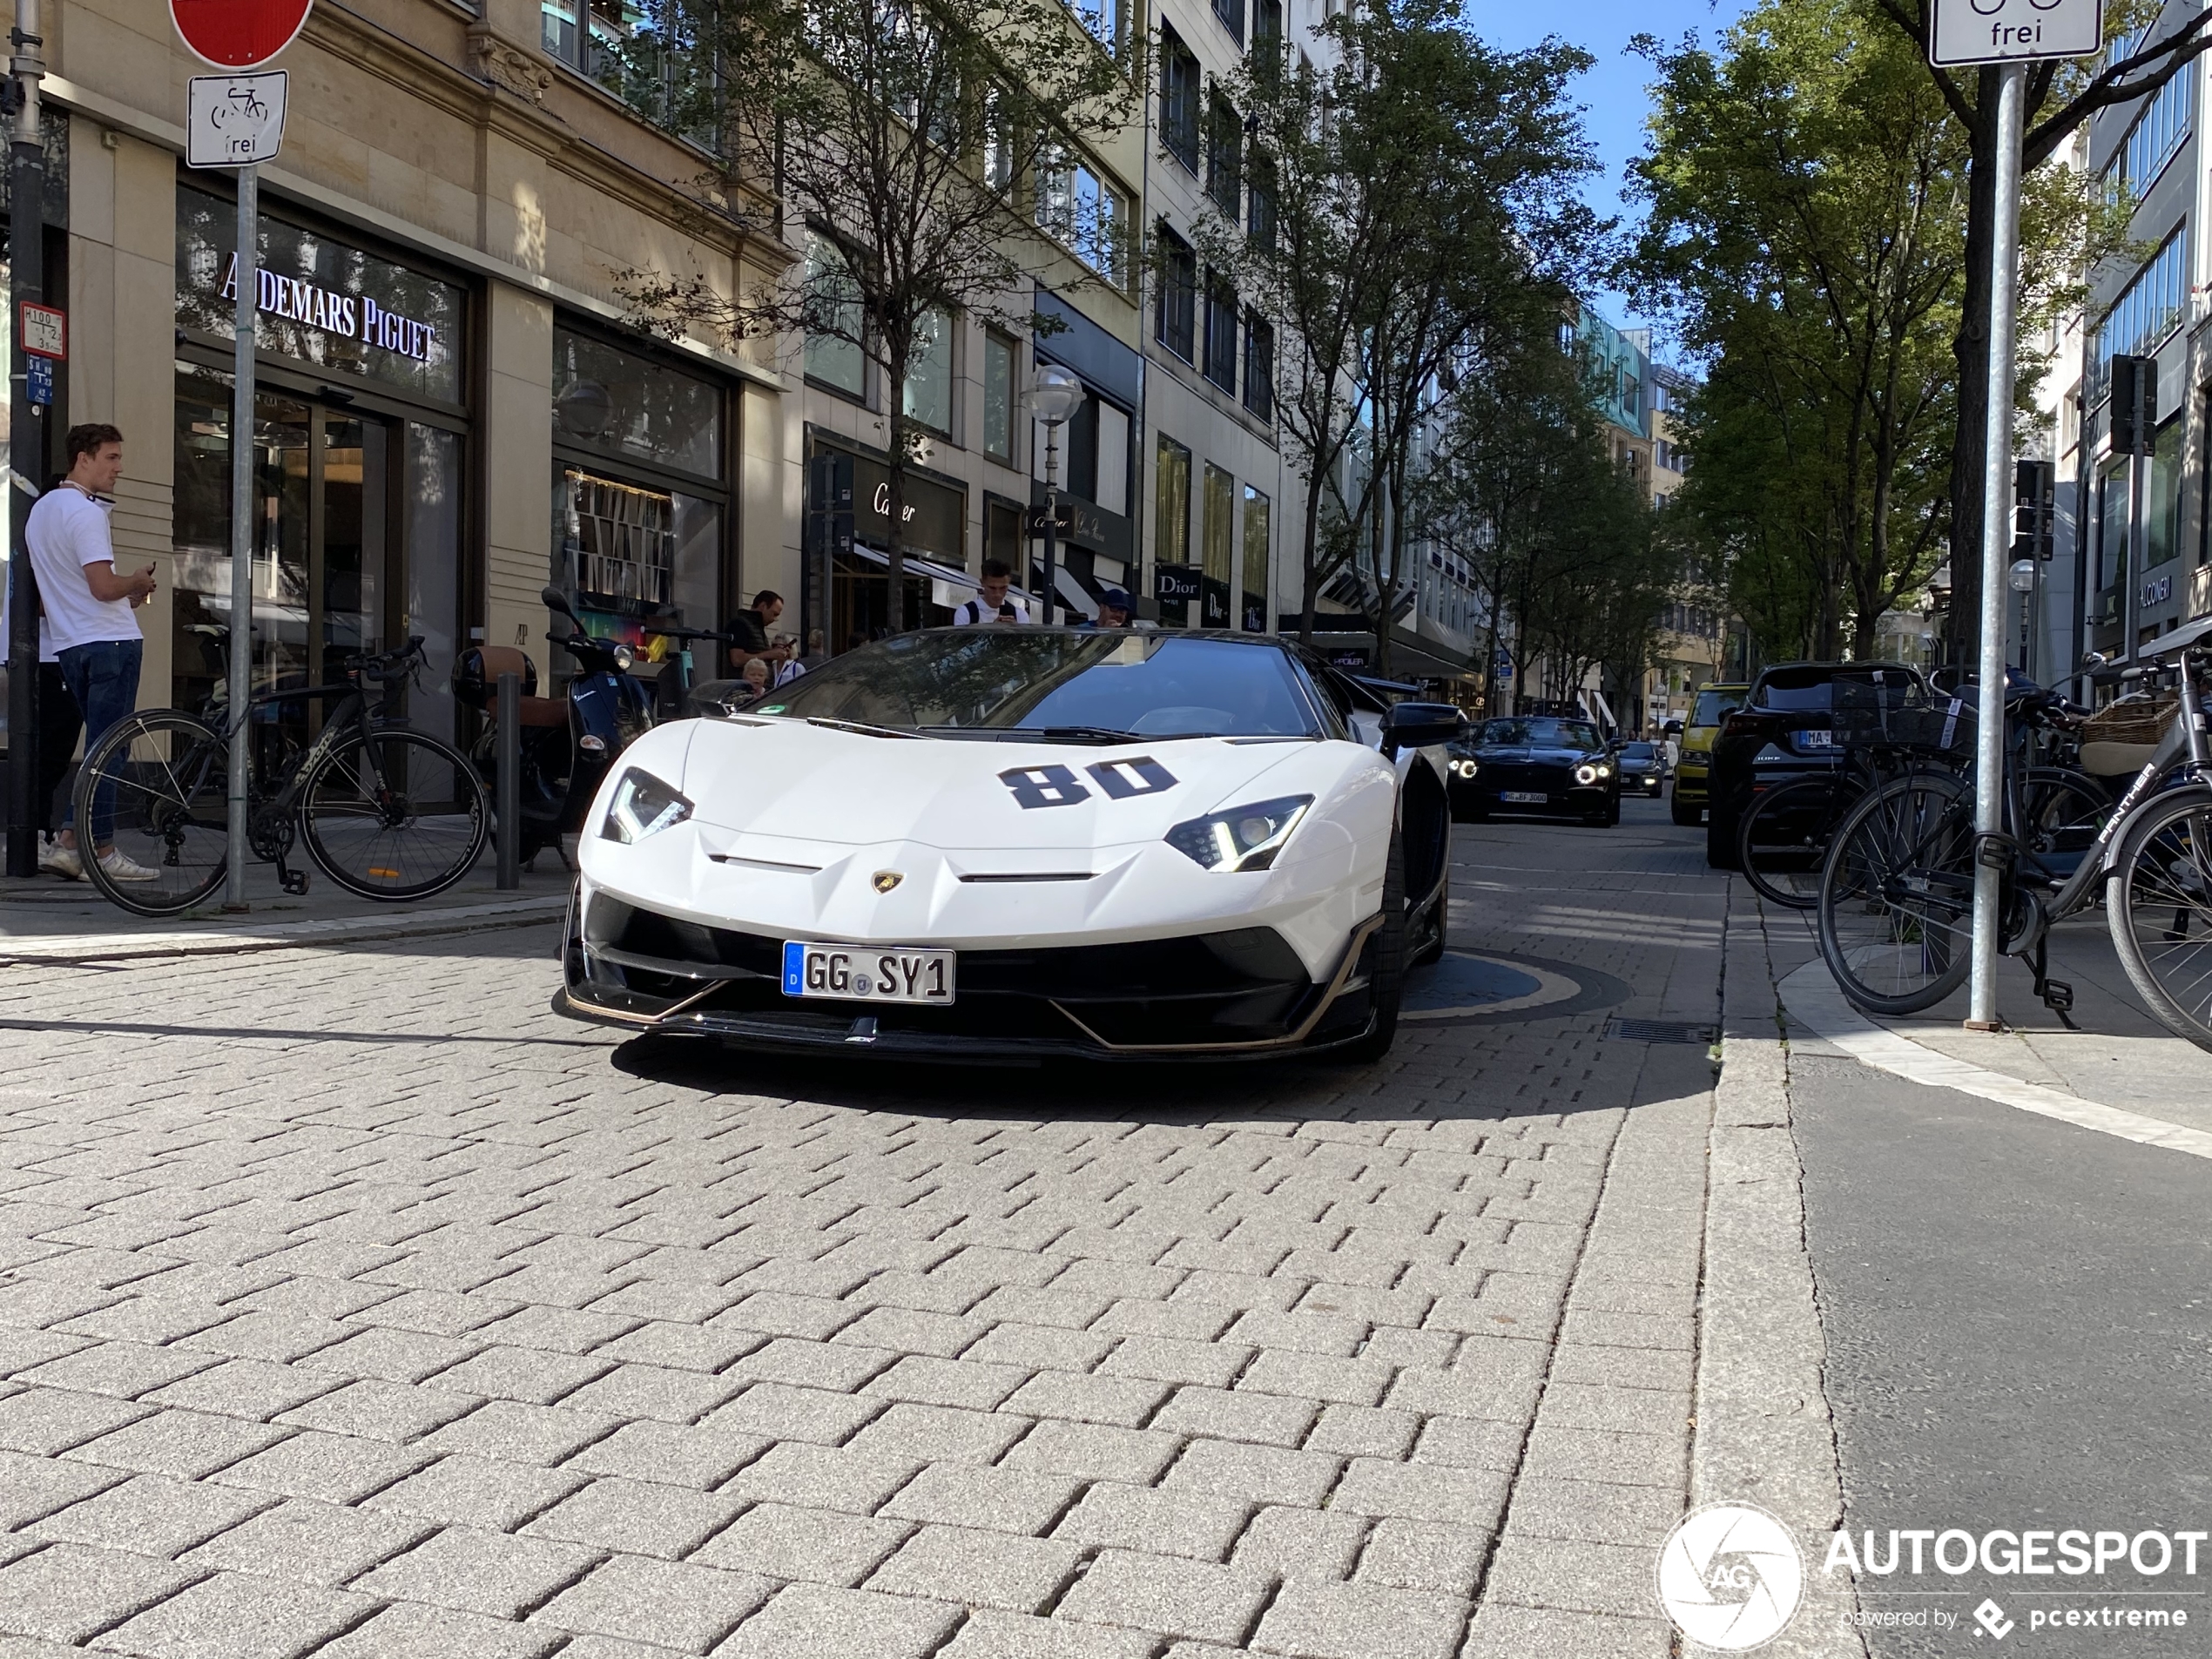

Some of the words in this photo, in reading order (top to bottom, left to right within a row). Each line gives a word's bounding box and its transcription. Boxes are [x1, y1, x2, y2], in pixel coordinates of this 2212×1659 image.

[1992, 18, 2041, 46] frei
[361, 295, 436, 362] PIGUET
[873, 482, 915, 523] Caer
[1158, 575, 1197, 594] Dior
[514, 624, 529, 645] AP
[1809, 732, 1823, 743] MA
[995, 755, 1181, 810] 80
[2098, 763, 2155, 844] PANTHER
[790, 974, 798, 986] D
[806, 951, 849, 991] GG
[877, 955, 947, 997] SY1
